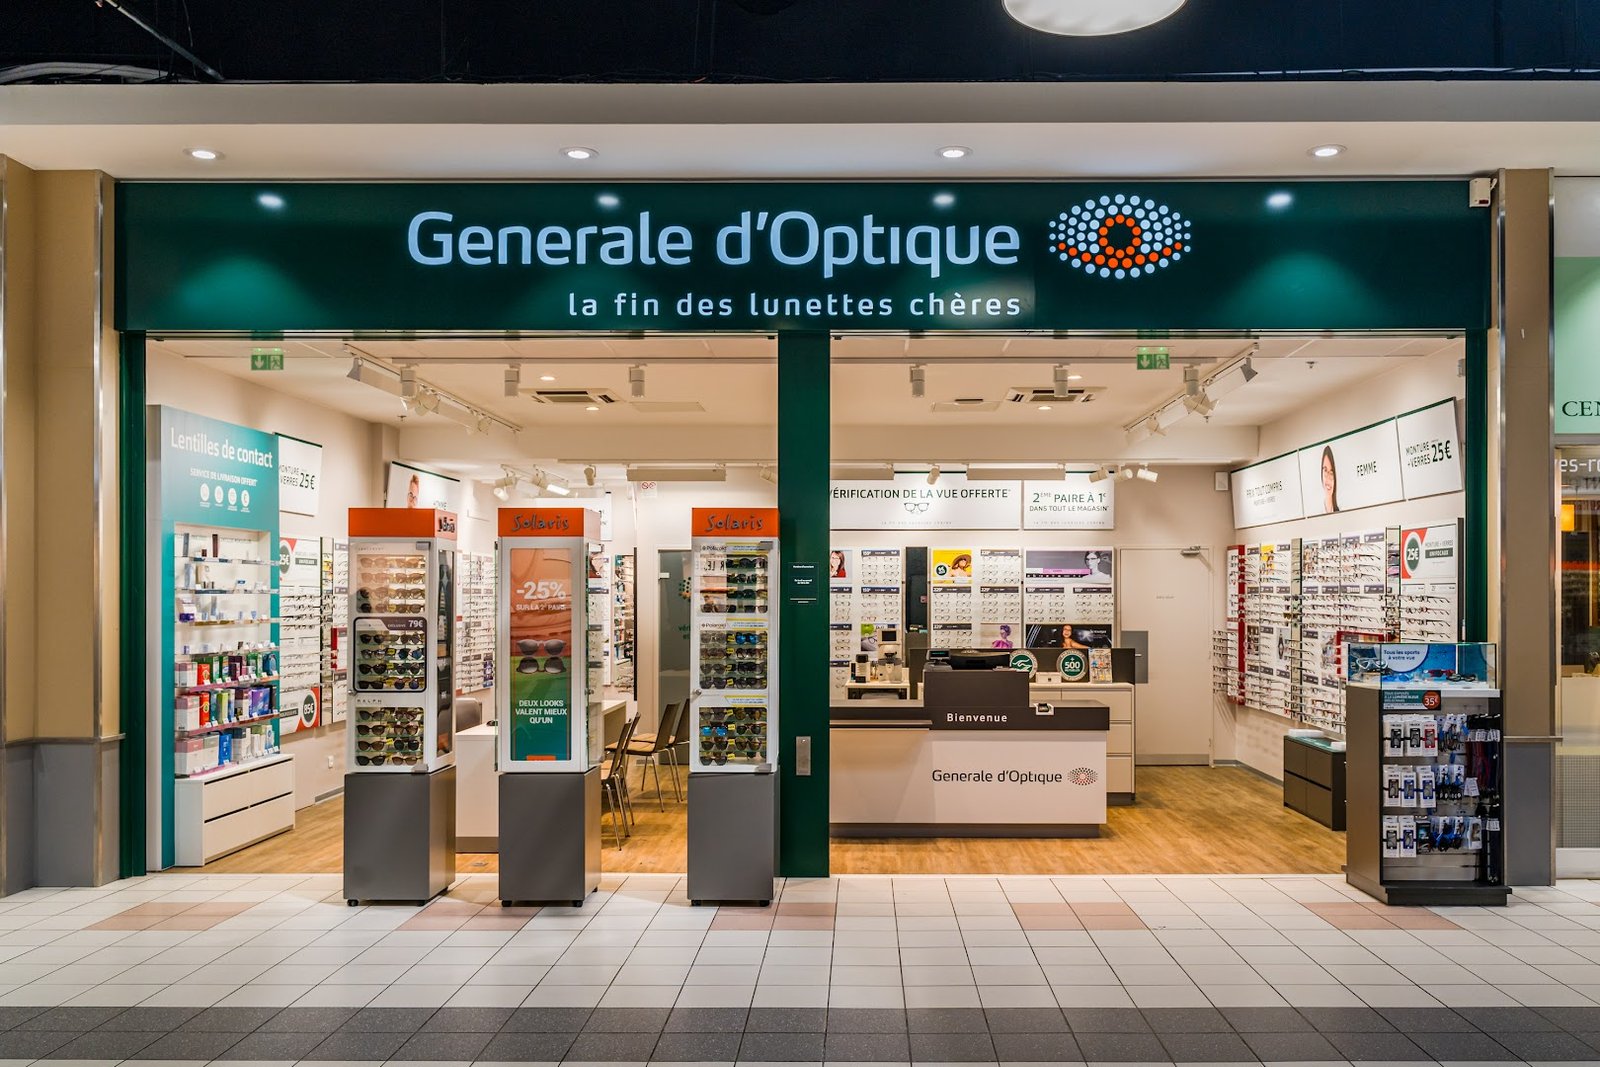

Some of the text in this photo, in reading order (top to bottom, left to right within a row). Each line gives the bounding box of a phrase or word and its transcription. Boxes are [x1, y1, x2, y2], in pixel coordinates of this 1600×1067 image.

[408, 210, 1020, 278] Generale d'Optique
[568, 292, 1021, 316] la fin des lunettes chères
[170, 427, 273, 468] Lentilles de contact
[1405, 441, 1430, 455] MONTURE
[1431, 440, 1452, 463] 25€
[190, 467, 209, 479] SERVICE
[1356, 461, 1377, 477] FEMME
[299, 472, 316, 490] 25€
[903, 489, 917, 499] DE
[920, 489, 934, 499] LA
[936, 489, 958, 499] VUE
[1054, 494, 1085, 503] PAIRE
[1086, 491, 1095, 503] À
[511, 513, 570, 532] Solaris
[704, 514, 763, 532] Solaris
[1406, 547, 1419, 561] 25€
[516, 581, 566, 600] -25%
[408, 619, 423, 628] 79€
[1064, 661, 1081, 669] 500
[303, 702, 315, 715] 85€
[946, 712, 1008, 723] Bienvenue
[931, 769, 1063, 785] Generale d'Optique
